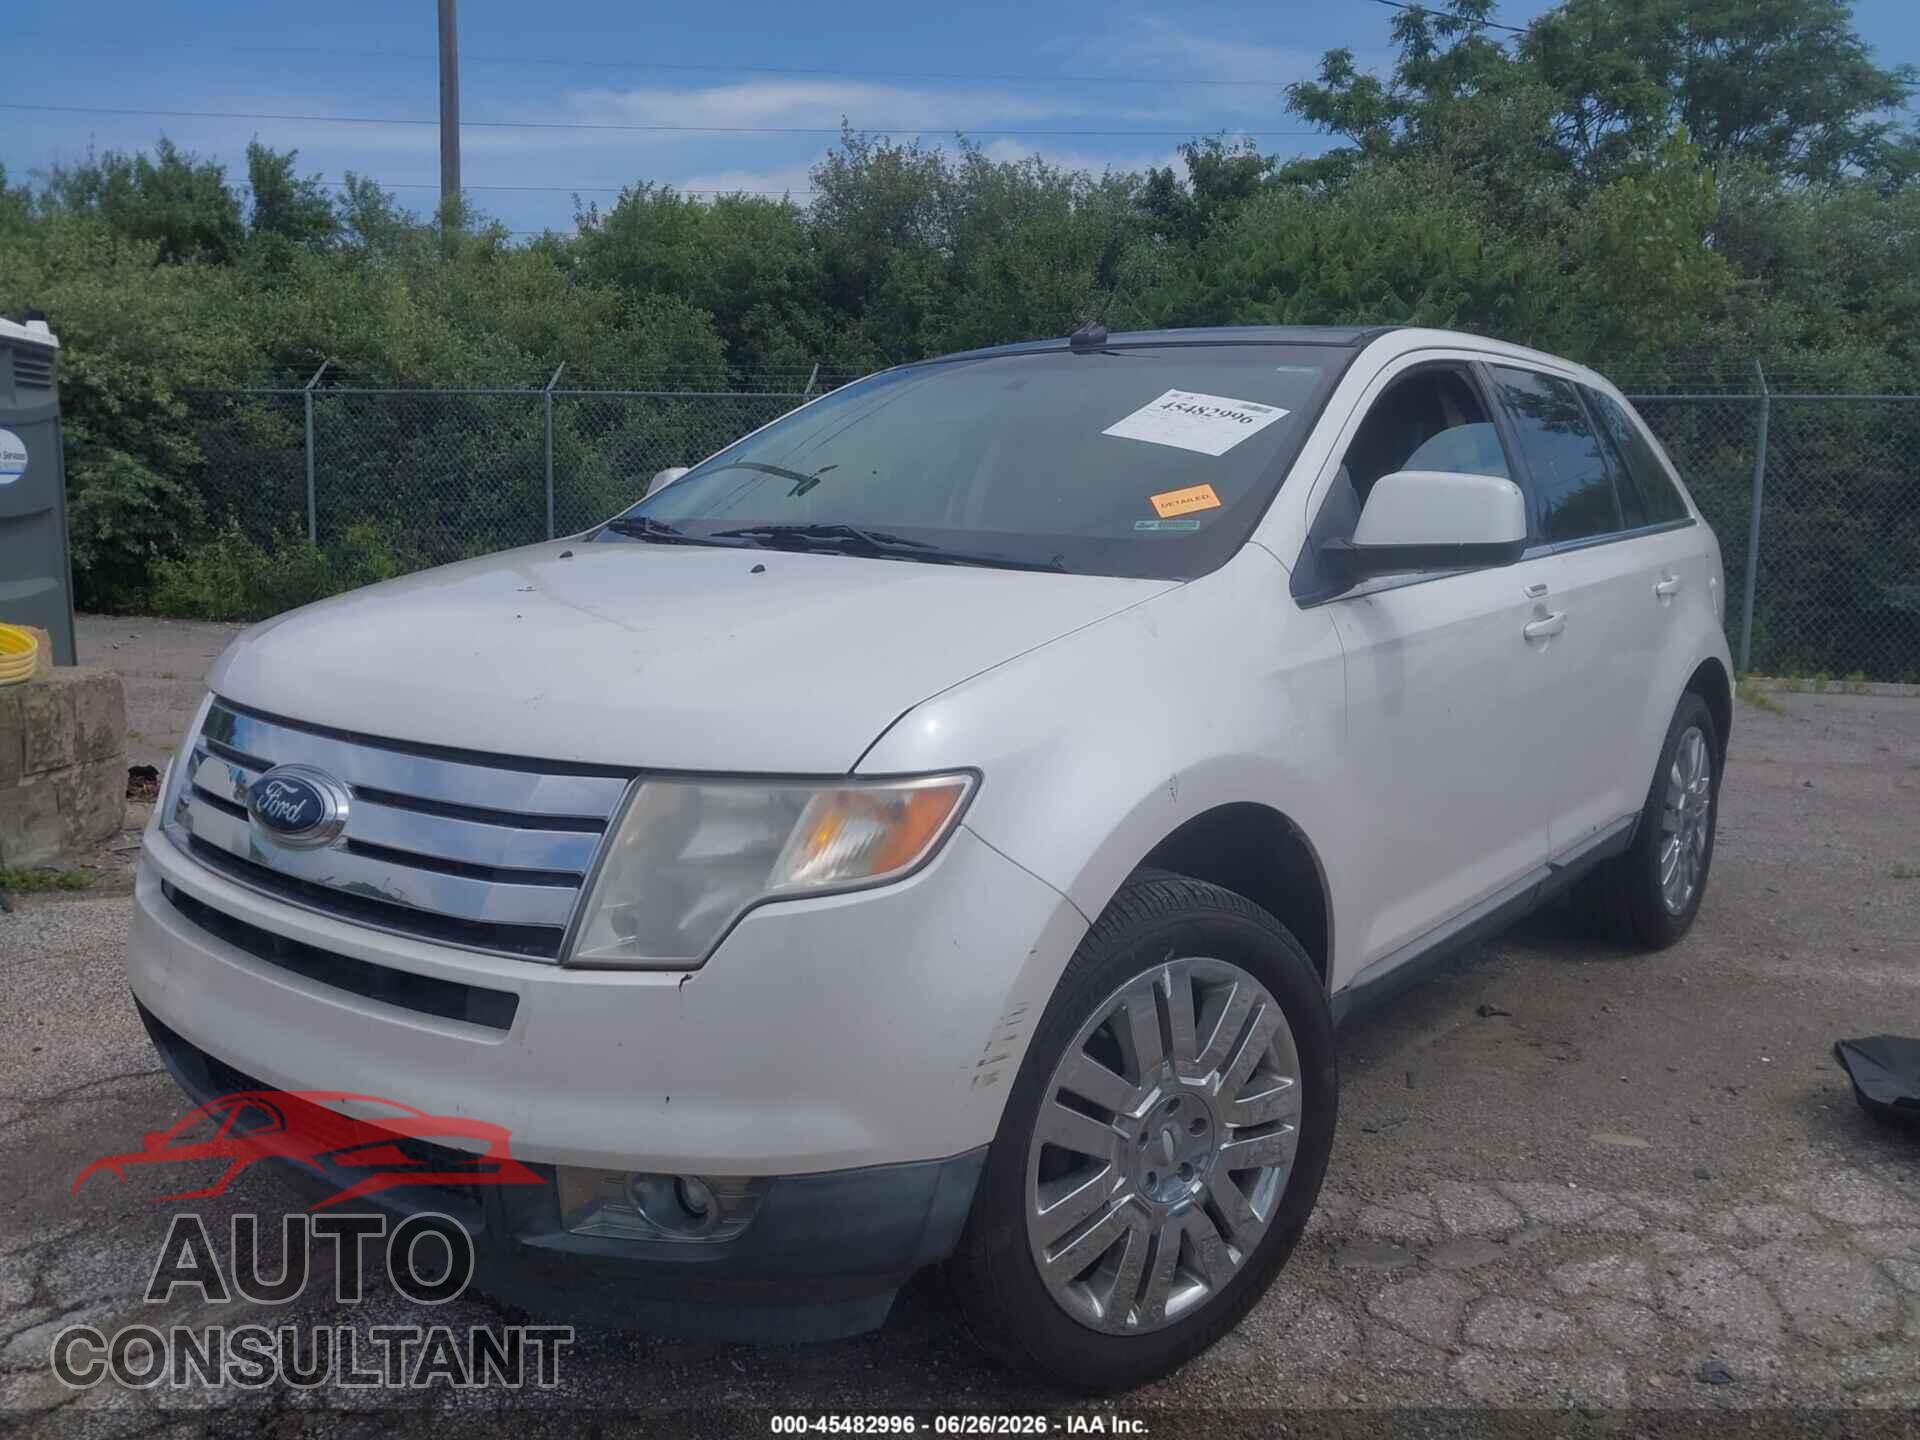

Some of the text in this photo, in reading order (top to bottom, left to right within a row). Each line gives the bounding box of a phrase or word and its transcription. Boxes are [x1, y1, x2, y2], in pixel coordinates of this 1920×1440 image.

[1160, 401, 1253, 424] 45482996
[1161, 494, 1210, 509] DETAILED
[256, 780, 308, 824] Ford
